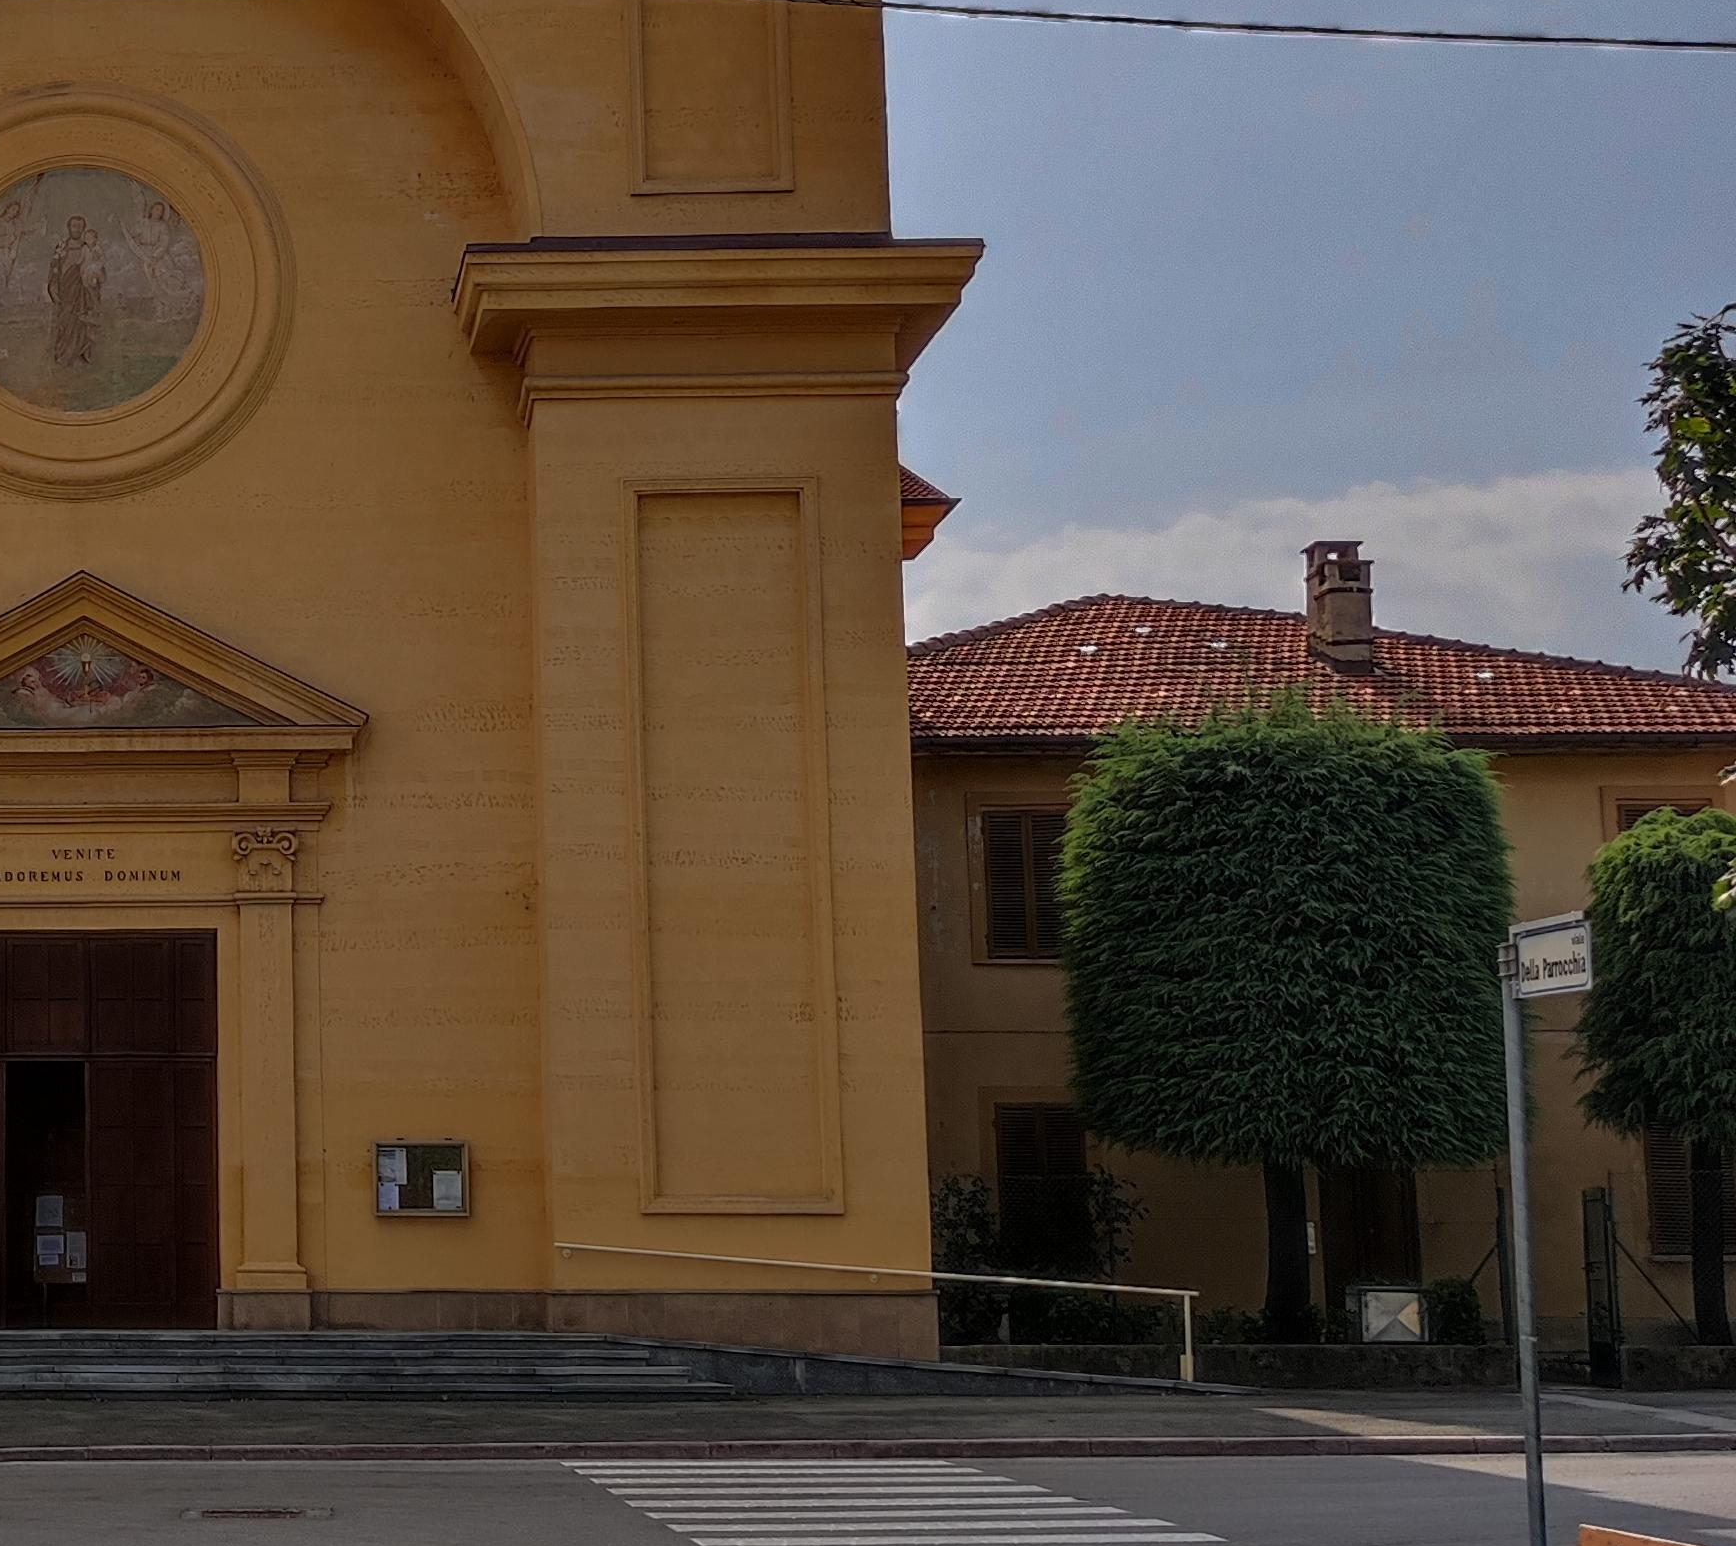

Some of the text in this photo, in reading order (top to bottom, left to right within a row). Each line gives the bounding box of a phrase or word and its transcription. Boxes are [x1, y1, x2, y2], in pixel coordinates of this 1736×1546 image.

[51, 848, 116, 860] VENITE
[104, 870, 181, 882] DOMINUM
[1571, 933, 1585, 945] viale
[1521, 951, 1586, 983] Della Parrocchia
